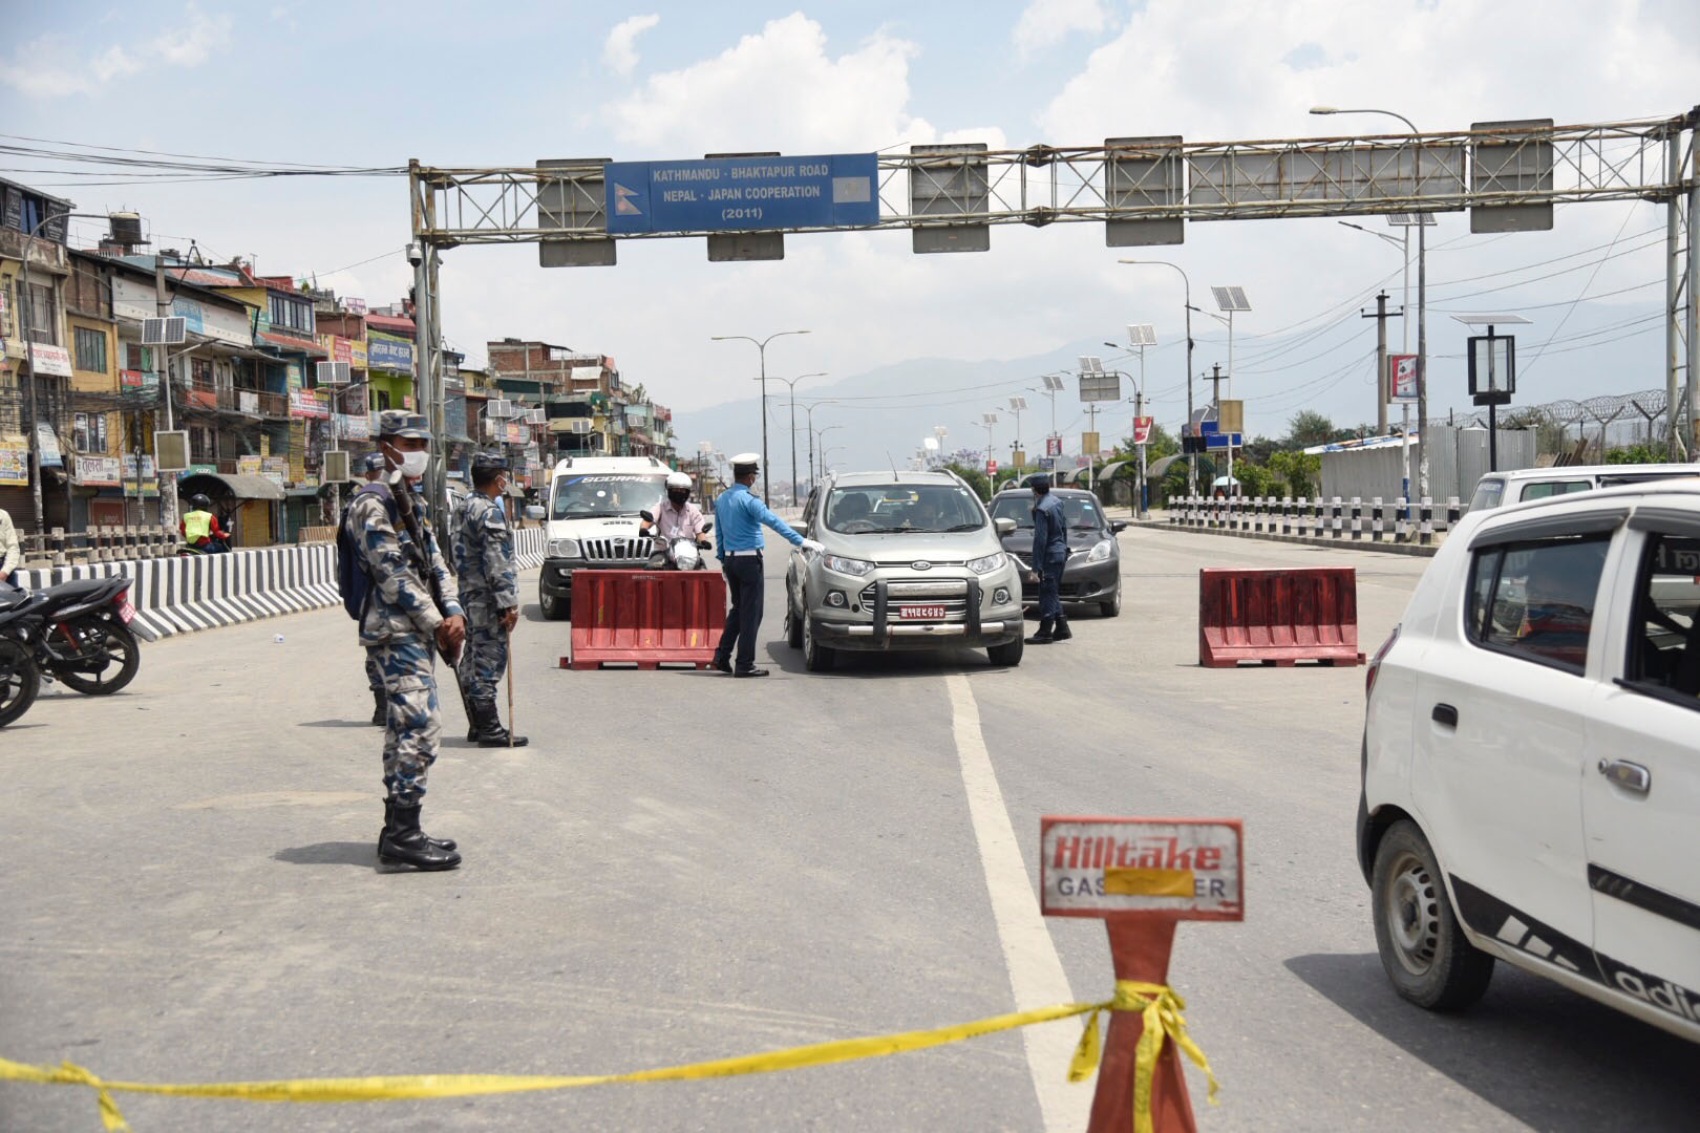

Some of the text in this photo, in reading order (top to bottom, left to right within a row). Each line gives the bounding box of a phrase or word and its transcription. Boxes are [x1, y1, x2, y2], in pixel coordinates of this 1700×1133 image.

[653, 167, 720, 182] KATHMANDU
[731, 165, 796, 179] BHAKTAPUR
[799, 164, 829, 177] ROAD
[663, 189, 698, 202] NEPAL
[708, 187, 742, 201] JAPAN
[745, 185, 821, 200] COOPERATION
[721, 207, 763, 221] (2011)
[581, 475, 652, 484] SCORPIO
[1053, 835, 1222, 871] Hilltake
[1615, 970, 1700, 1024] adi
